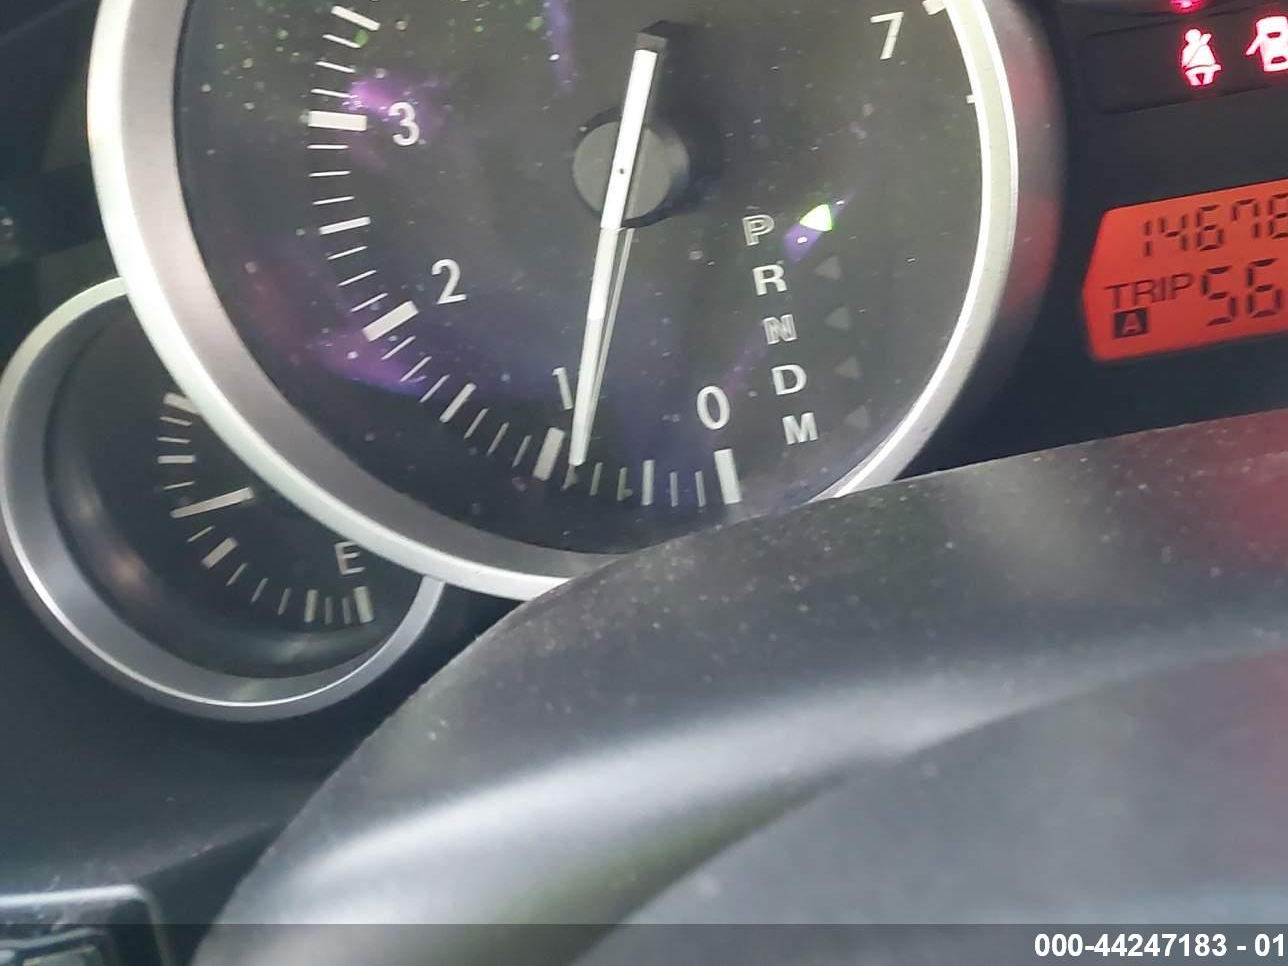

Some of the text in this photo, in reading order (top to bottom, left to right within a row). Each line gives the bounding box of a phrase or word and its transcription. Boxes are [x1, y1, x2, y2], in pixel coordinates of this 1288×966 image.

[870, 11, 904, 60] 7
[391, 102, 421, 146] 3
[742, 214, 775, 246] P
[432, 259, 467, 305] 2
[752, 264, 788, 296] R
[1103, 273, 1194, 309] TRIP
[762, 314, 798, 345] N
[1117, 309, 1146, 337] A
[552, 367, 574, 410] 1
[771, 364, 807, 395] D
[697, 385, 731, 430] 0
[782, 412, 819, 445] M
[335, 541, 366, 575] E
